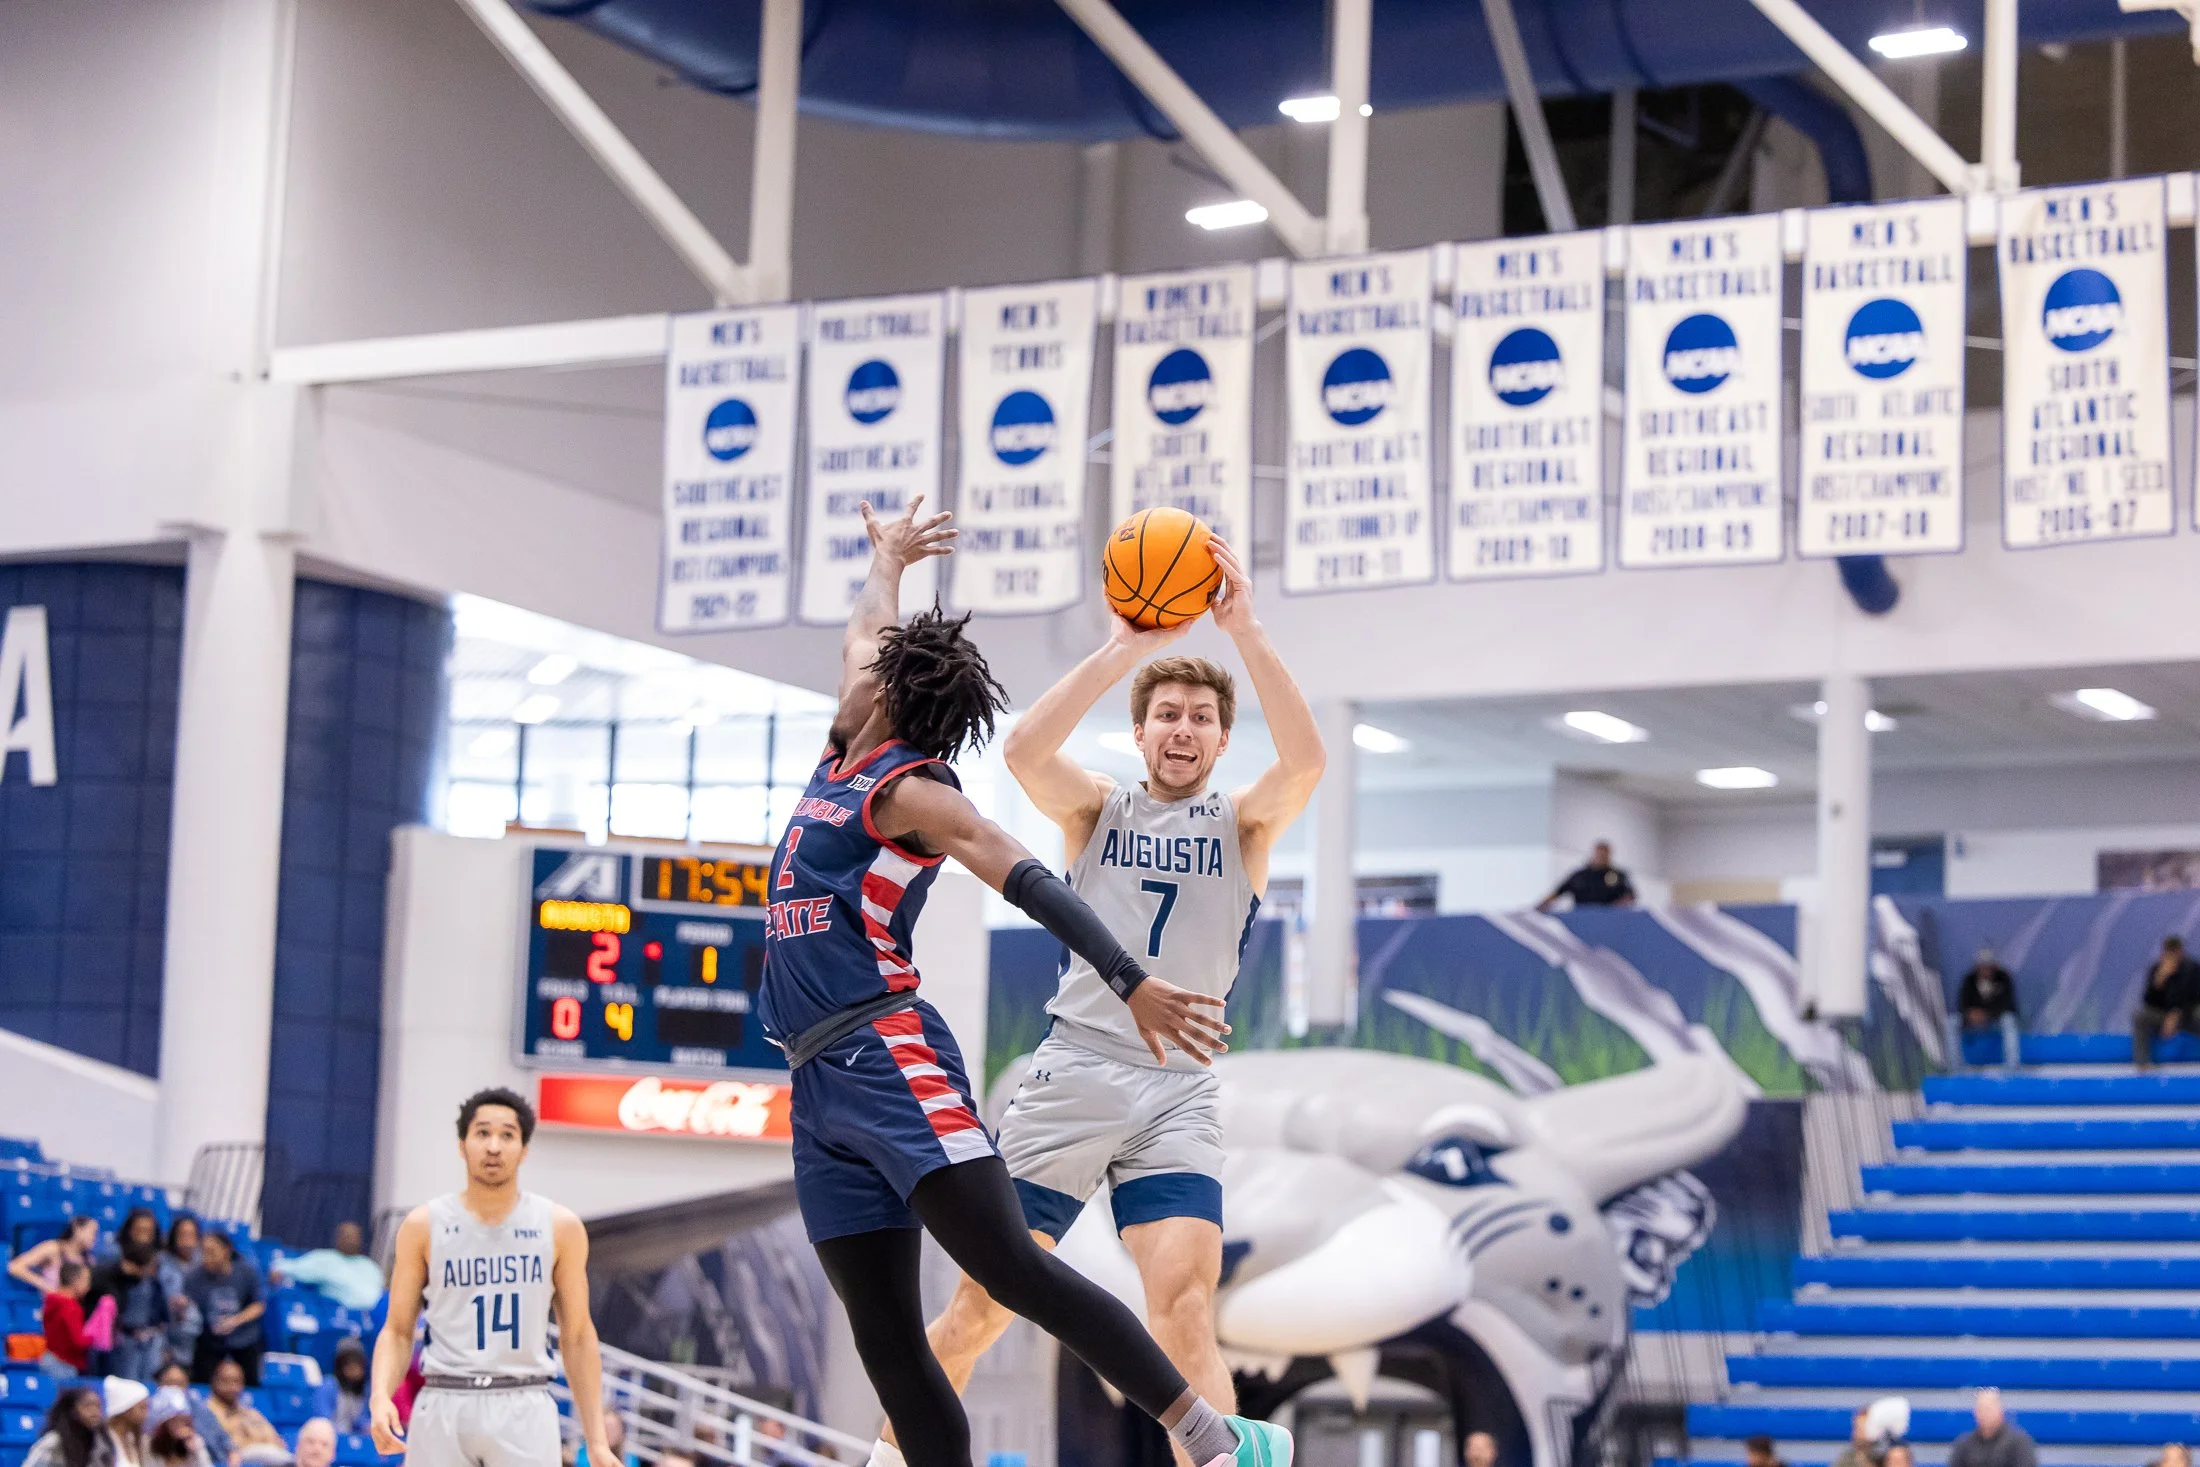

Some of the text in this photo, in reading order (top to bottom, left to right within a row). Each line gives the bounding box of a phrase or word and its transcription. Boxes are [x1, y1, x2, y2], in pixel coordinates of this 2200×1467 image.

[2046, 192, 2116, 223] MEN'S
[1670, 233, 1737, 262] MEN'S
[1851, 217, 1920, 248] MEN'S
[2010, 222, 2156, 262] BASKETBALL
[1497, 248, 1561, 277] MEN'S
[1814, 254, 1953, 291] BASKETBALL
[1147, 283, 1231, 312] WOMEN'S
[1330, 267, 1390, 297] MEN'S
[1637, 268, 1770, 302] BASKETBALL
[1000, 300, 1059, 329] MEN'S
[1460, 284, 1591, 319] BASKETBALL
[710, 318, 762, 345] MEN'S
[820, 310, 932, 341] VOLLEYBALL
[1122, 315, 1242, 344] BASKETBALL
[1298, 304, 1420, 335] BASKETBALL
[2045, 303, 2124, 336] NCAA
[991, 343, 1062, 373] TENNIS
[1666, 347, 1741, 379] NCAA
[1848, 333, 1926, 364] NCAA
[679, 355, 786, 386] BASKETBALL
[1491, 362, 1563, 394] NCAA
[2049, 361, 2118, 392] SOUTH
[1326, 381, 1394, 411] NCAA
[1805, 387, 1956, 423] SOUTH ATLANTIC
[2033, 391, 2137, 431] ATLANTIC
[1464, 417, 1591, 452] SOUTHEAST
[1640, 402, 1767, 437] SOUTHEAST
[820, 440, 924, 473] SOUTHEAST
[1151, 431, 1209, 458] SOUTH
[1298, 432, 1421, 467] SOUTHEAST
[1824, 430, 1934, 461] REGIONAL
[2032, 430, 2137, 465] REGIONAL
[1134, 460, 1224, 490] ATLANTIC
[1473, 460, 1577, 490] REGIONAL
[1647, 445, 1754, 477] REGIONAL
[674, 475, 782, 506] SOUTHEAST
[970, 482, 1065, 512] NATIONAL
[1305, 474, 1407, 505] REGIONAL
[681, 516, 770, 545] REGIONAL
[2039, 500, 2139, 536] 2006-07
[777, 826, 804, 891] 2
[1100, 828, 1223, 878] AUGUSTA
[657, 856, 770, 907] 17:54
[1140, 877, 1180, 960] 7
[586, 931, 620, 984] 2
[702, 945, 718, 984] 1
[551, 995, 634, 1042] 0 4
[444, 1255, 543, 1288] AUGUSTA
[472, 1292, 520, 1350] 14
